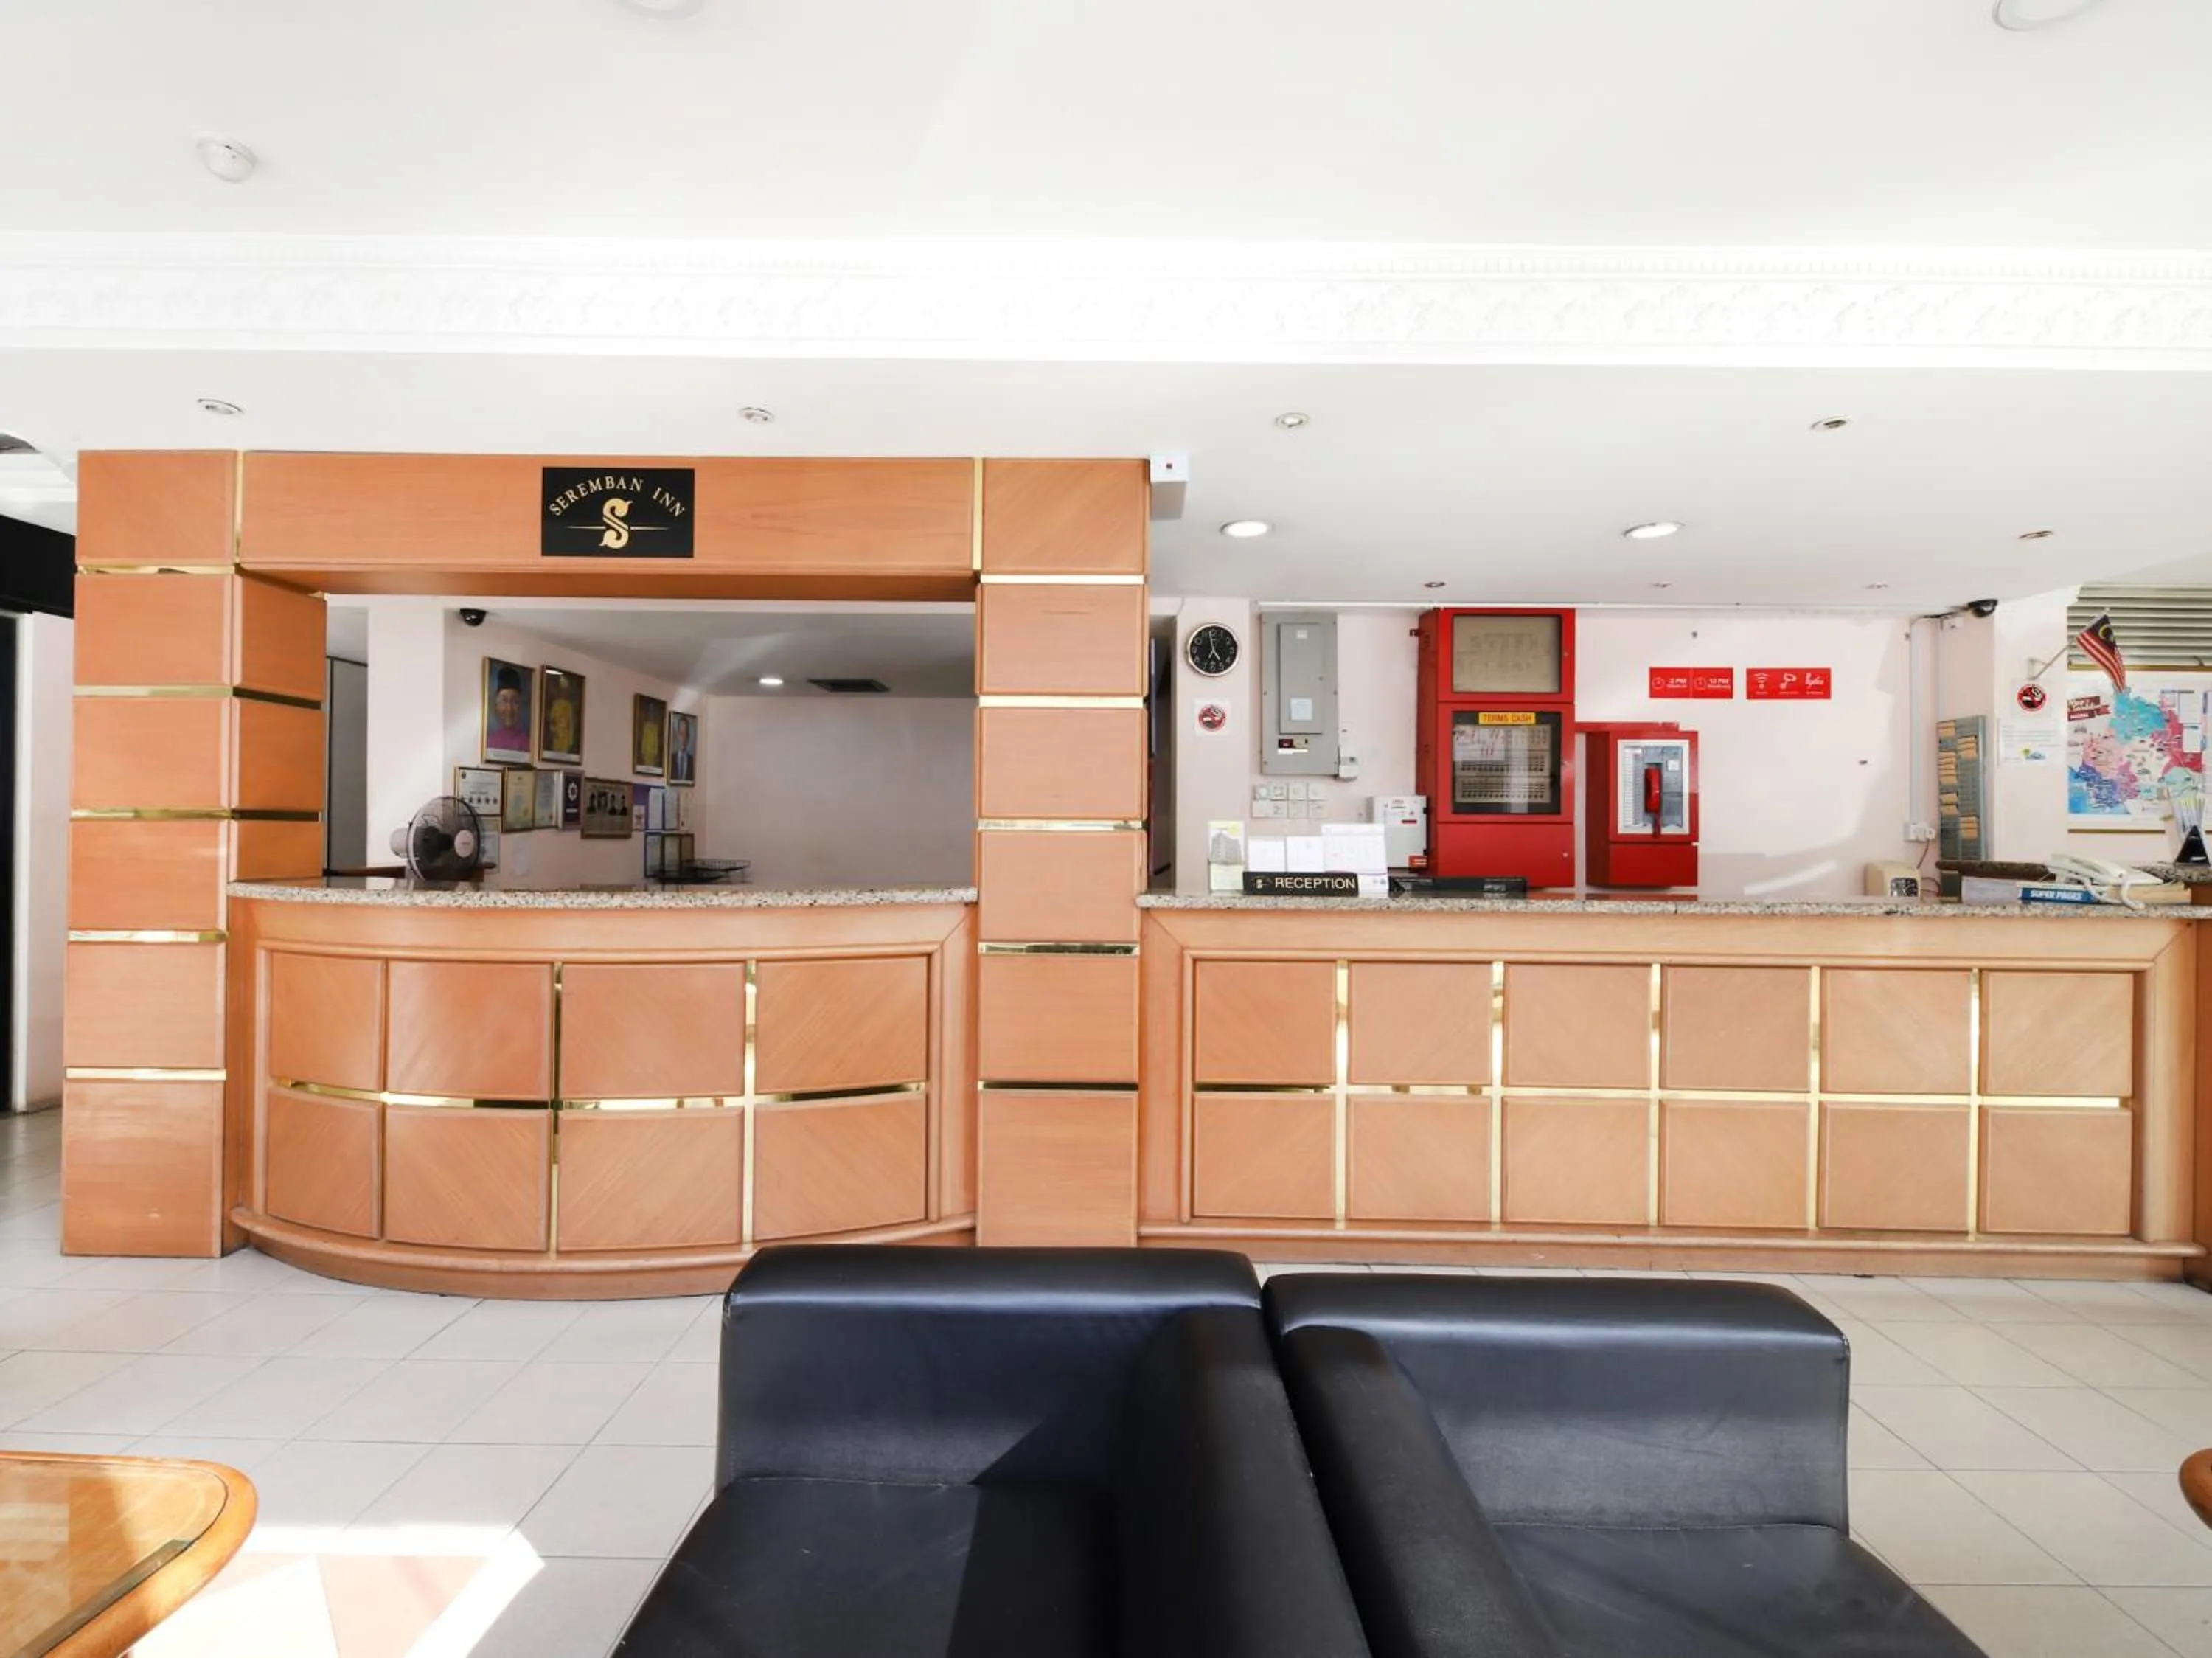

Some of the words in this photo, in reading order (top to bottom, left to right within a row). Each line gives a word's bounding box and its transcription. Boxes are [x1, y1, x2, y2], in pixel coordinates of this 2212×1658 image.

[549, 476, 644, 516] SEREMBAN
[652, 486, 685, 516] INN
[1274, 877, 1356, 889] RECEPTION
[2030, 889, 2056, 898] SUPER
[2056, 891, 2083, 901] PAGES
